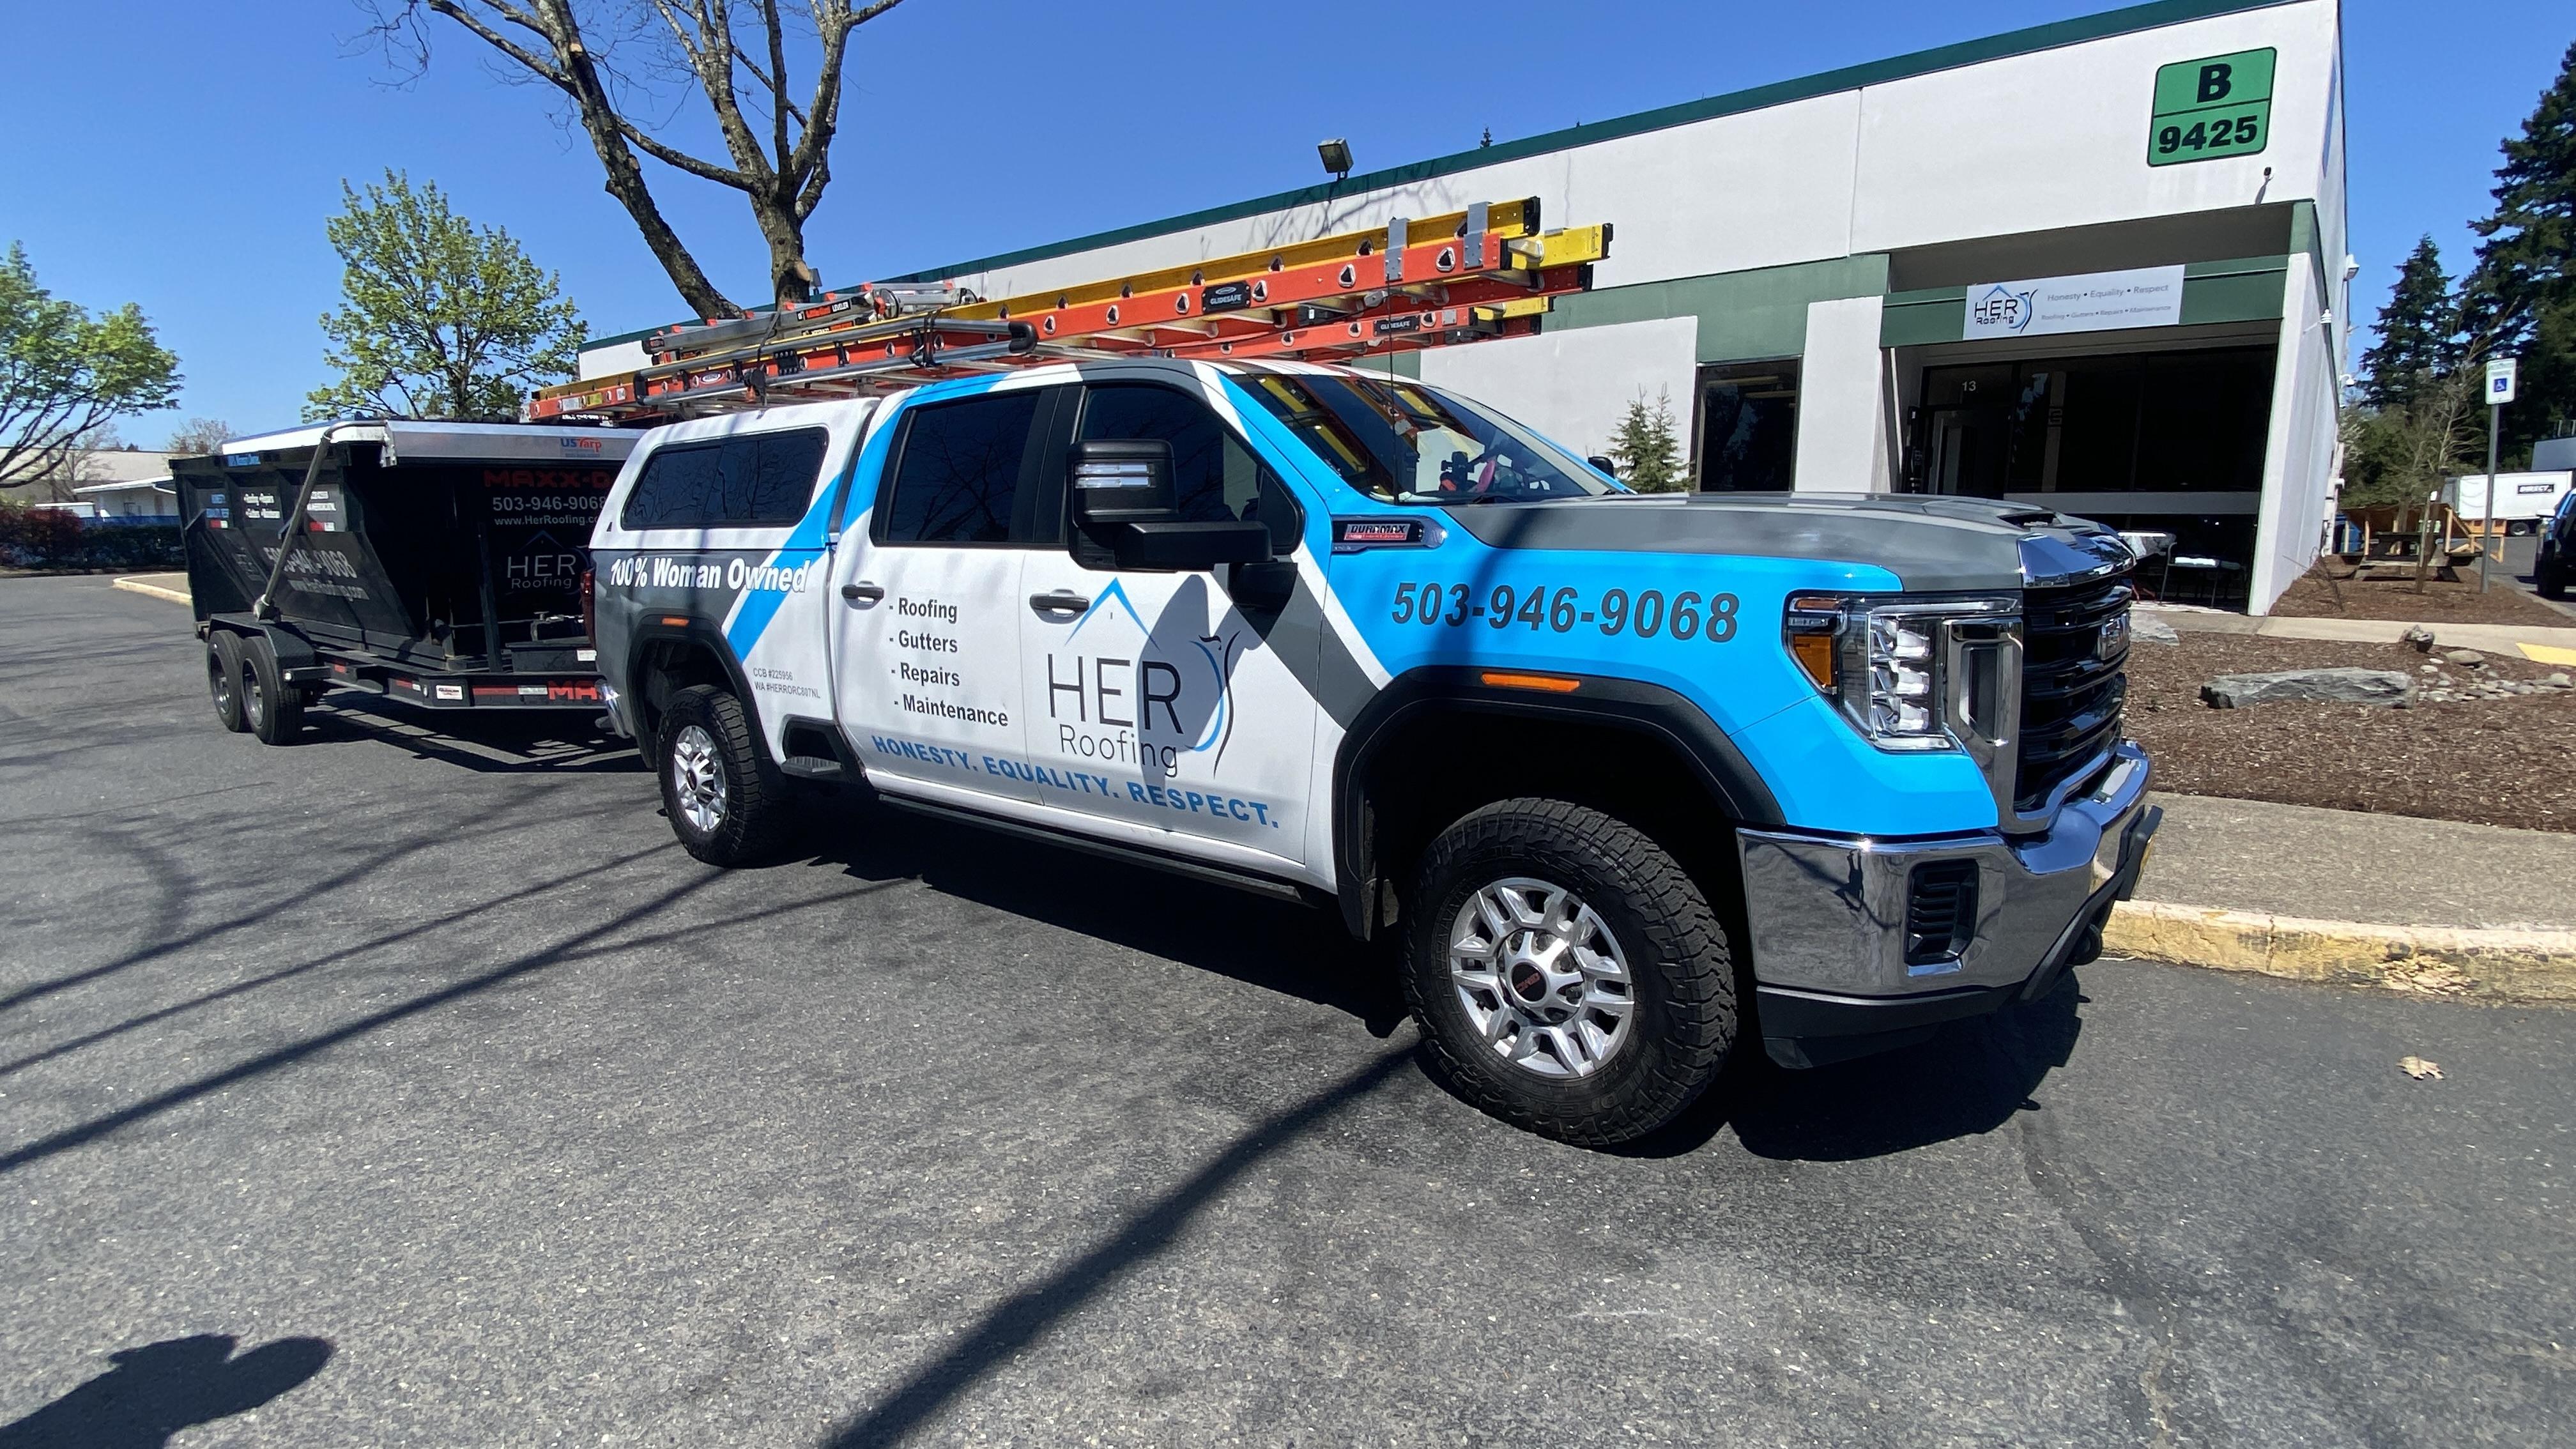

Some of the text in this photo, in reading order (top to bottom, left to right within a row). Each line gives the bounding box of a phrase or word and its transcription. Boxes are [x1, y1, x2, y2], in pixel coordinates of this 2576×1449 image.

[2196, 63, 2232, 103] B
[2159, 115, 2258, 154] 9425
[1210, 294, 1242, 305] GLIDESAFE
[2048, 284, 2169, 302] Honesty Equality Respect
[1975, 298, 2018, 318] HER
[1976, 313, 2014, 325] Roofing
[1962, 380, 1977, 392] 13
[493, 496, 606, 511] 503-946-9068
[1351, 525, 1406, 533] DURAMAX
[507, 554, 576, 578] HER
[610, 557, 811, 594] 100% Woman Owned
[511, 576, 572, 590] Roofing
[898, 598, 958, 624] Roofing
[1391, 582, 1740, 643] 503-946-9068
[898, 631, 958, 654] Gutters
[753, 668, 767, 678] CCB
[900, 663, 960, 687] Repairs
[548, 680, 603, 700] MA
[754, 681, 766, 691] WA
[1047, 653, 1183, 735] HER
[903, 696, 1009, 727] Maintenance
[1059, 723, 1177, 777] Roofing
[871, 735, 1279, 829] HONESTY. EQUALITY. RESPECT.
